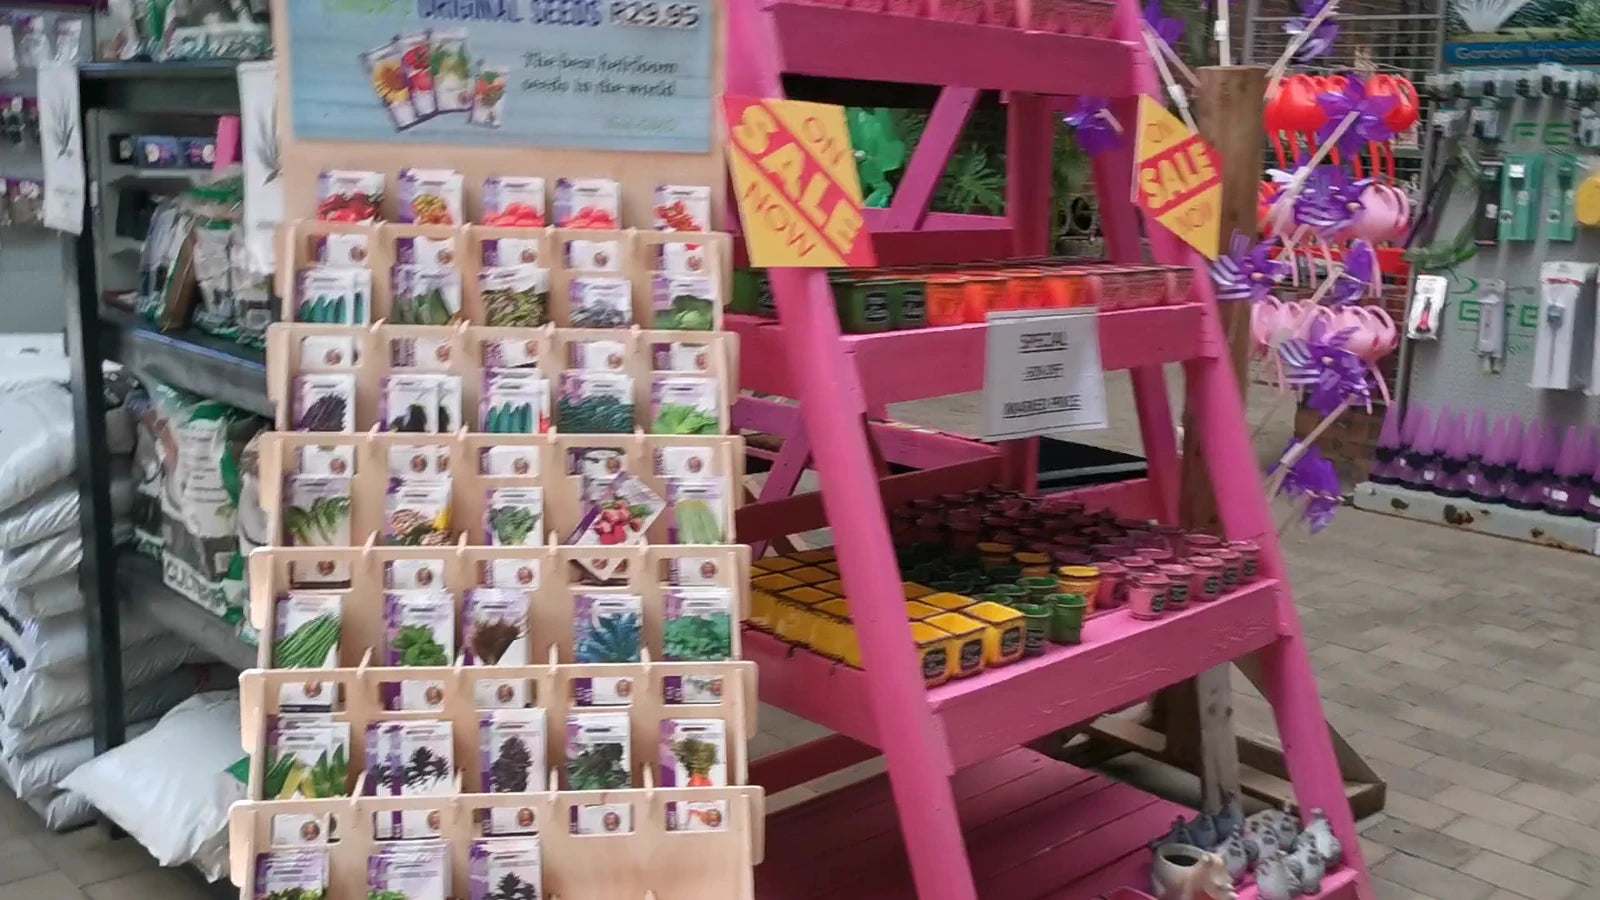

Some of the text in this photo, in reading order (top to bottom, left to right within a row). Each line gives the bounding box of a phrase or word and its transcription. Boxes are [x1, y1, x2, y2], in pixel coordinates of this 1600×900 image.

[417, 0, 523, 23] ORIGINAL
[530, 0, 601, 26] SEEDS
[609, 1, 699, 29] R29.95
[596, 79, 626, 94] the
[802, 117, 844, 167] ON
[731, 104, 864, 256] SALE
[1140, 141, 1219, 209] SALE
[744, 181, 816, 257] NOW
